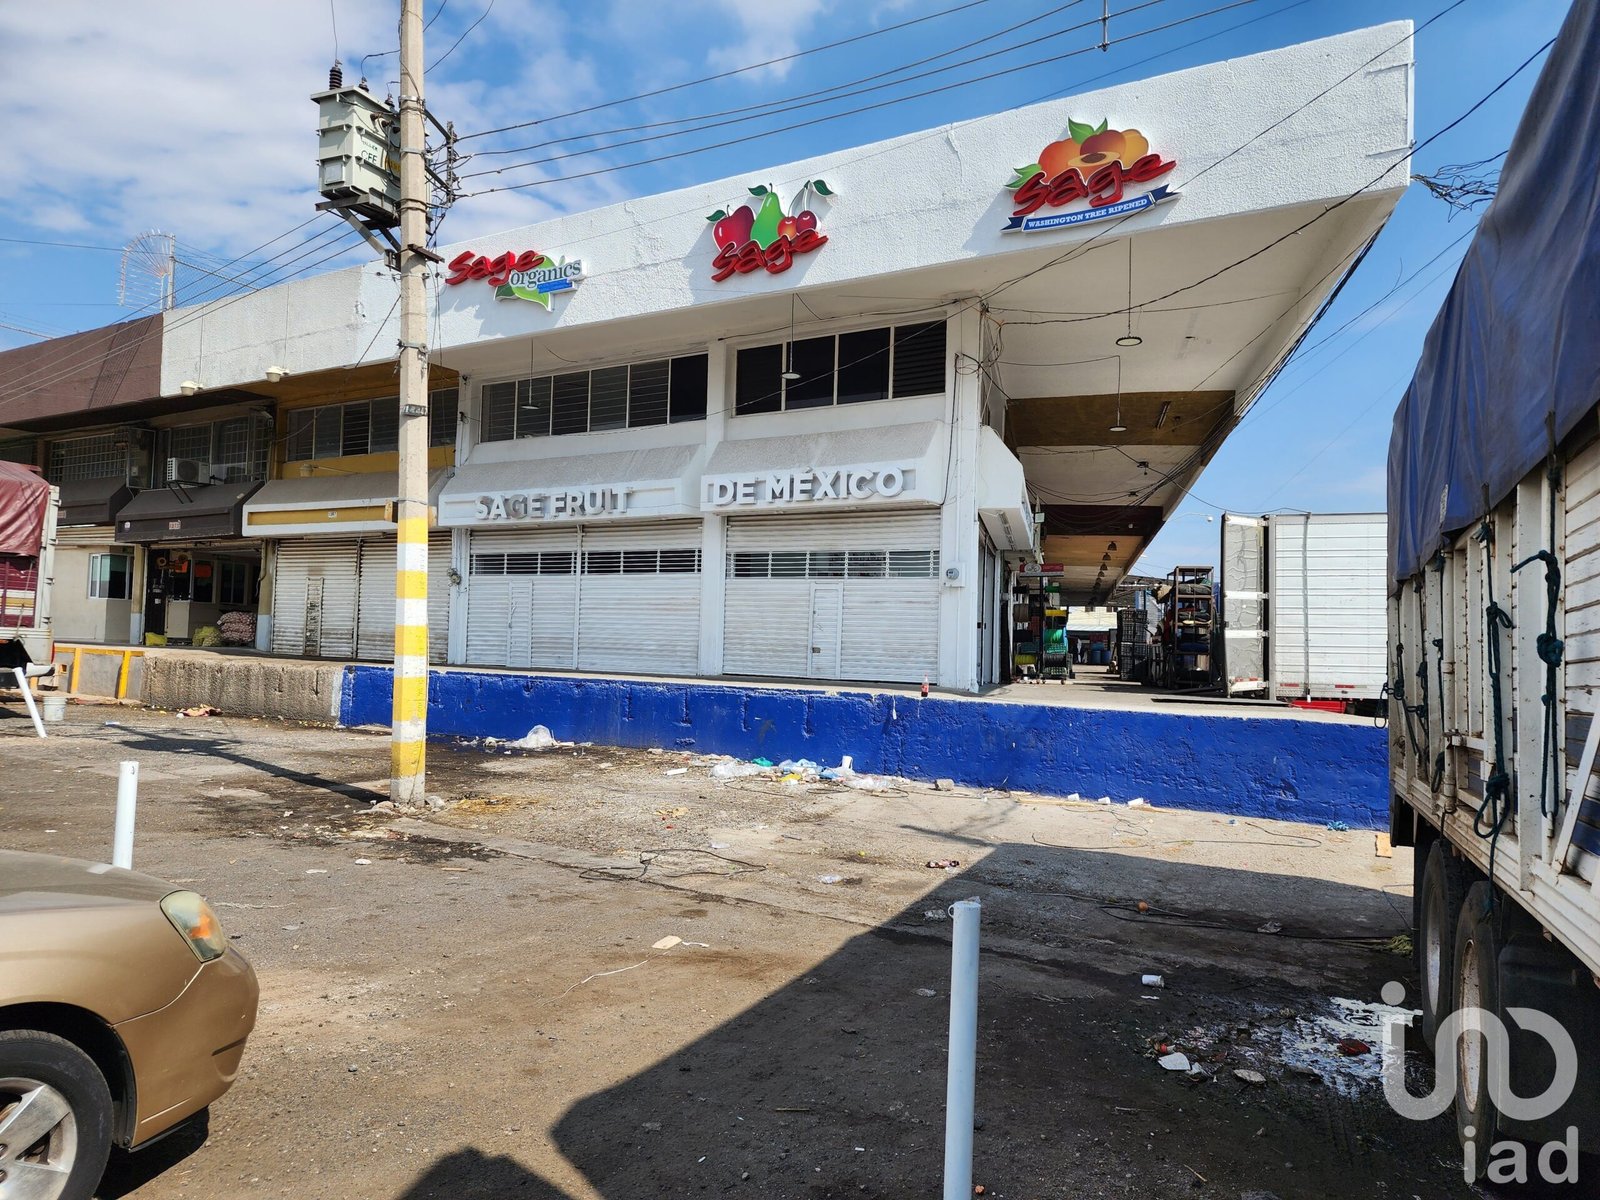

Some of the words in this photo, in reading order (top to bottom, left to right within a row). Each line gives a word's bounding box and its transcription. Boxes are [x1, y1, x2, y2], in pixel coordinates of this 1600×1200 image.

[1028, 213, 1084, 229] WASHINGTON
[1085, 209, 1108, 220] TREE
[1108, 198, 1149, 214] RIPENED
[510, 259, 582, 289] organics
[713, 476, 758, 506] DE
[765, 465, 906, 503] MÉXICO
[474, 492, 546, 522] SAGE
[549, 486, 634, 519] FRUIT
